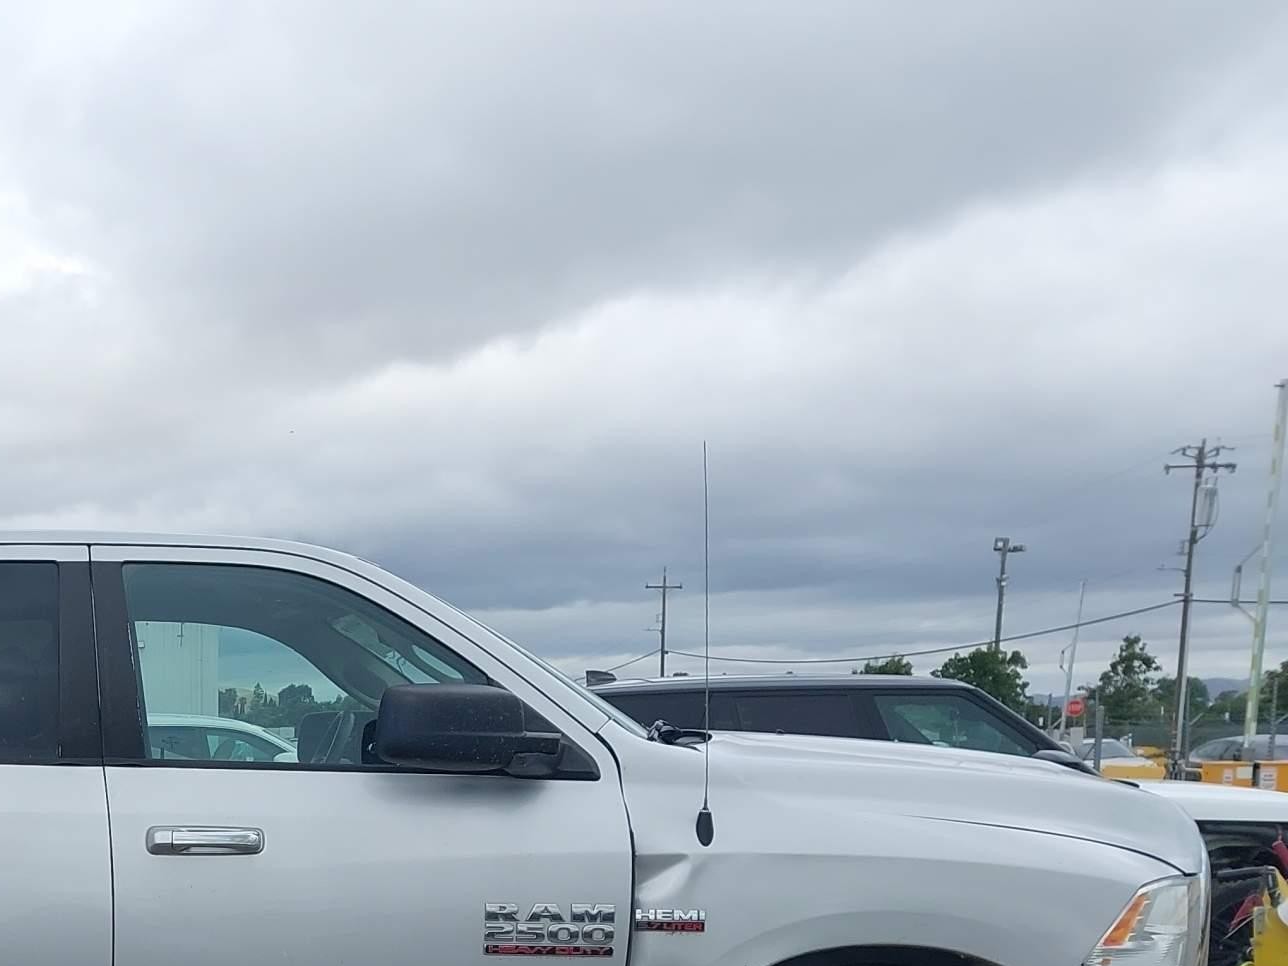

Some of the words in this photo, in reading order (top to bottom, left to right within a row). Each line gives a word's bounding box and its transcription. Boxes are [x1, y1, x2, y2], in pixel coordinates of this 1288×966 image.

[484, 903, 616, 923] RAM
[635, 909, 706, 921] HEMI
[663, 922, 703, 931] LITER
[483, 922, 615, 944] 2500
[488, 944, 554, 954] HEAVY
[555, 945, 611, 955] DUTY
